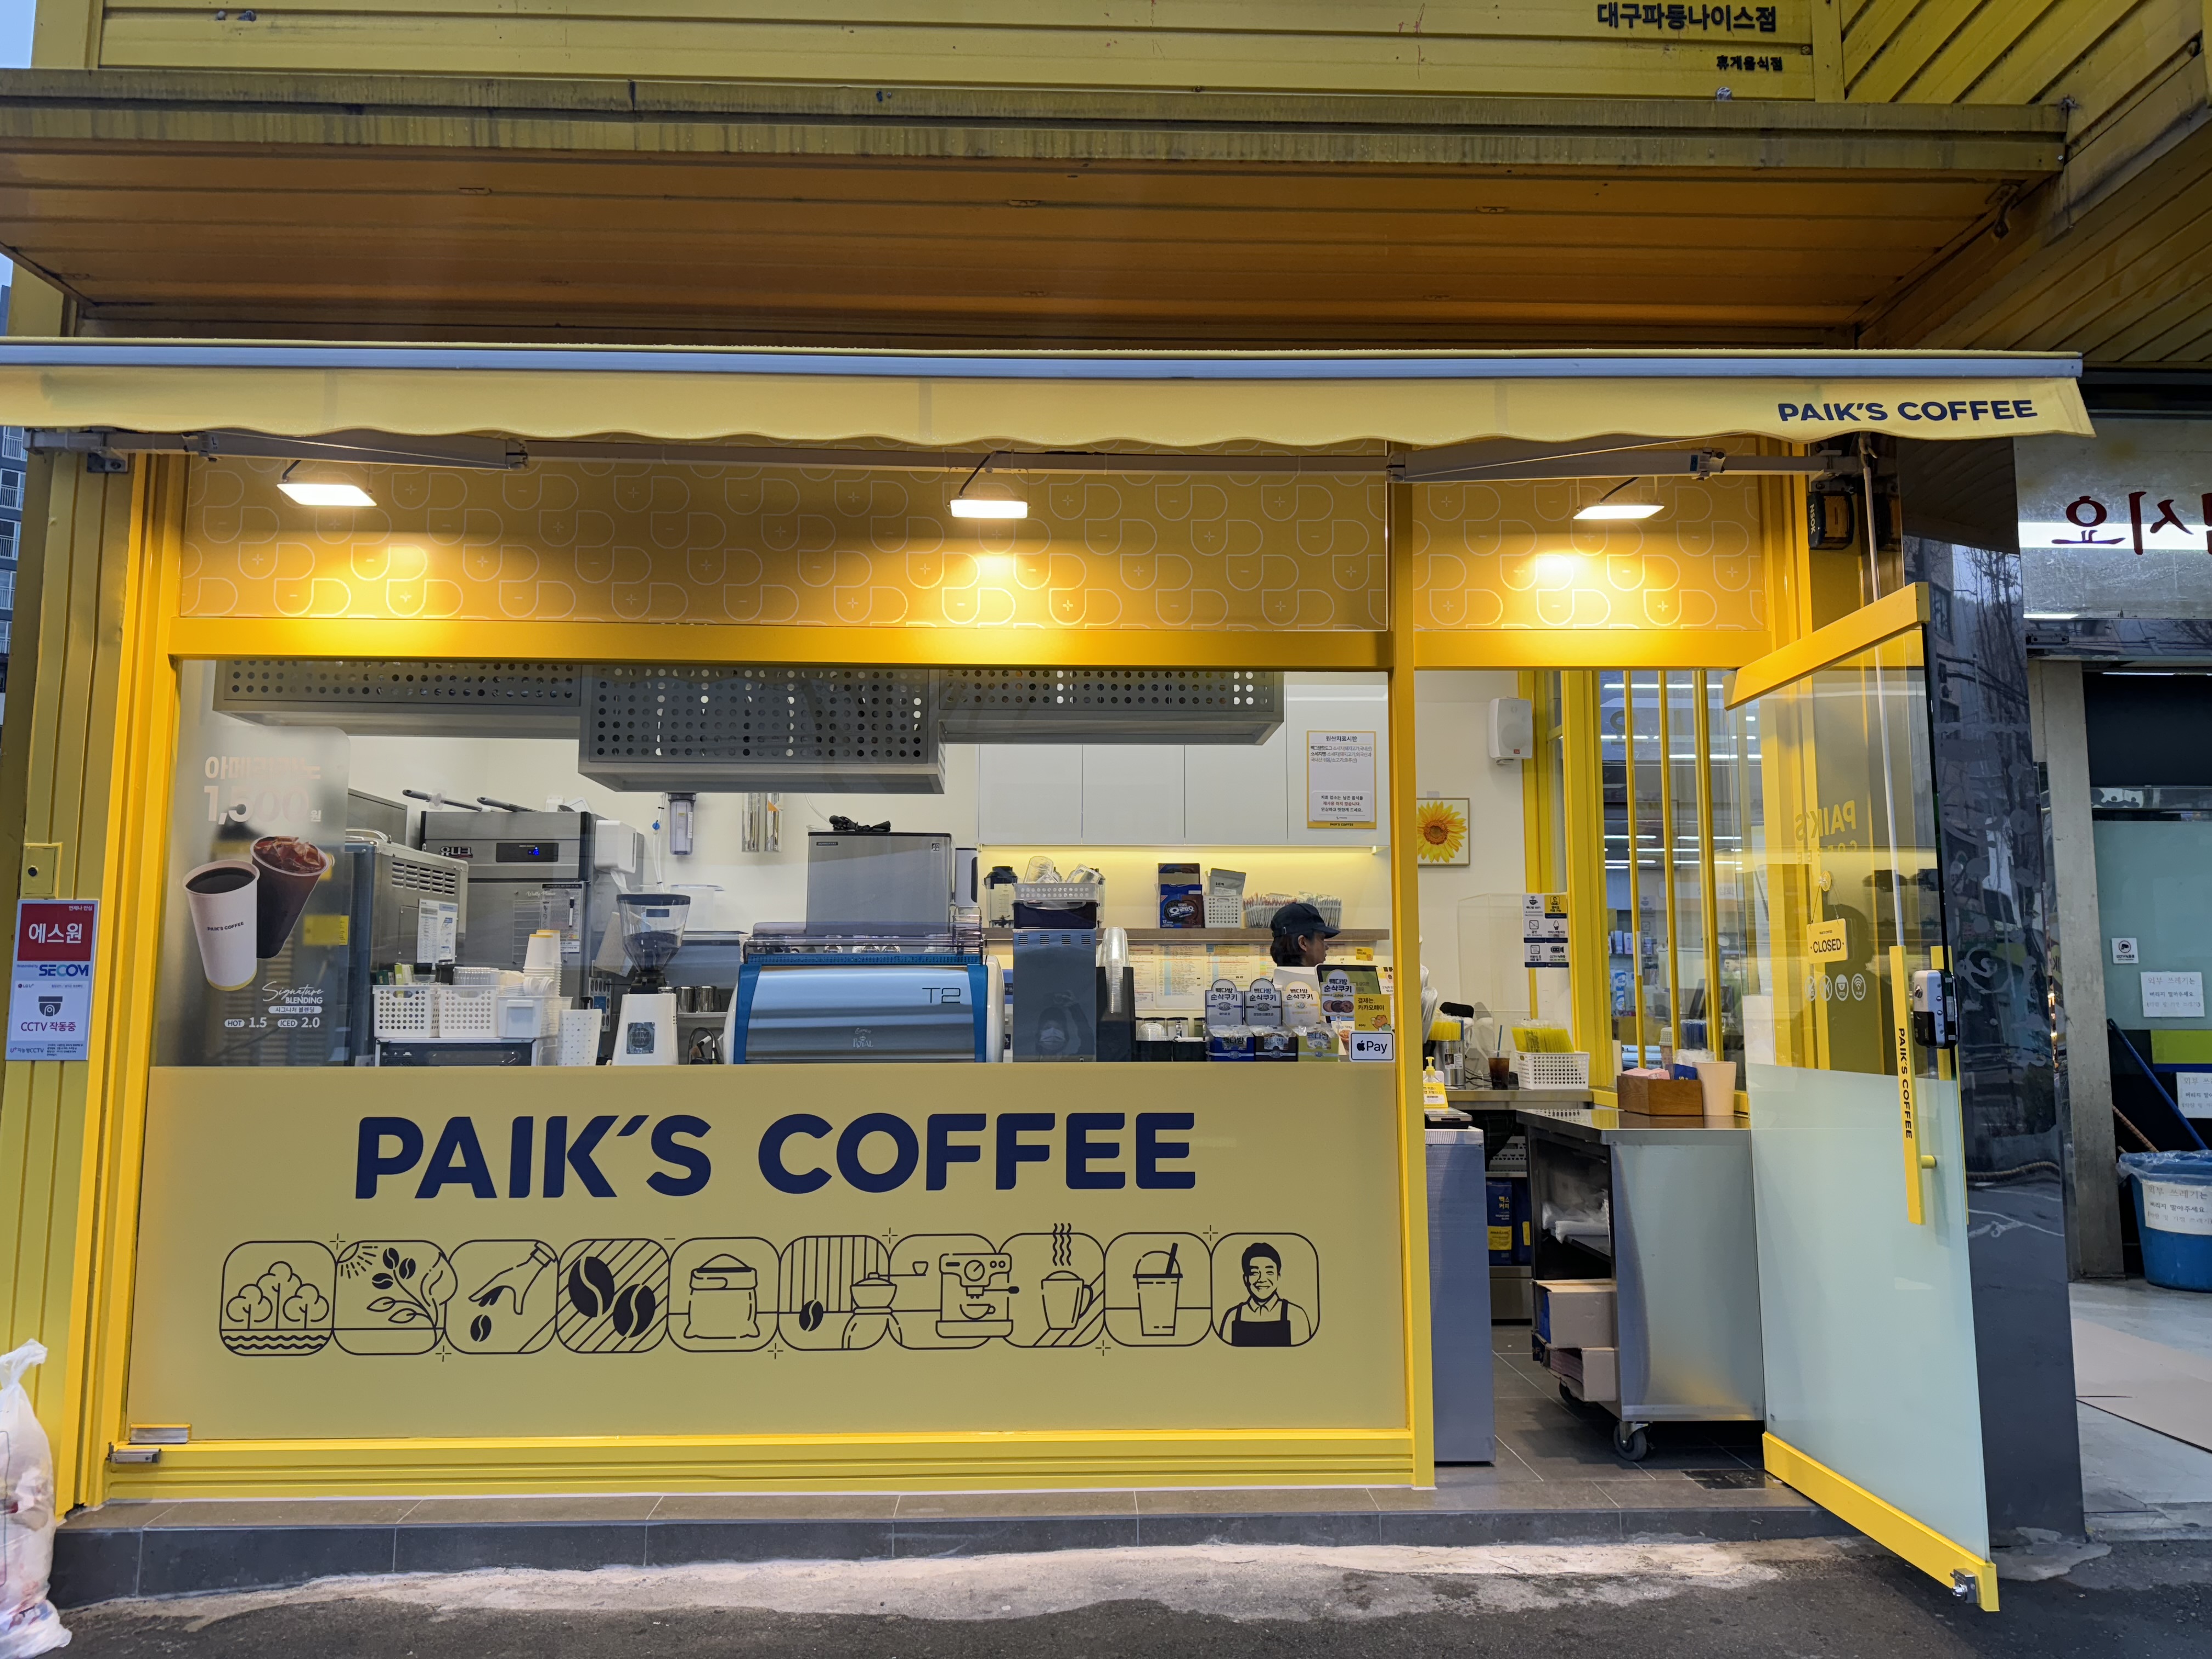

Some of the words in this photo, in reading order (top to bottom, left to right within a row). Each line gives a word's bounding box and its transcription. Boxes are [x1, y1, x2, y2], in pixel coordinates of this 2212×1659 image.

[1597, 2, 1776, 32] 대구파동나이스점
[1717, 55, 1783, 71] 휴게음식점
[1778, 402, 1888, 421] PAIK'S
[1898, 400, 2038, 421] COFFEE
[440, 846, 472, 857] 유니크
[29, 923, 82, 944] 에스원
[1813, 938, 1841, 953] CLOSED
[39, 964, 89, 977] SECOM
[262, 981, 324, 1001] Signature
[922, 988, 961, 1003] T2
[21, 1022, 47, 1031] CCTV
[49, 1022, 76, 1031] 작동중
[249, 1017, 267, 1028] 1.5
[301, 1017, 320, 1028] 2.0
[1367, 1041, 1387, 1054] Pay
[1899, 1028, 1908, 1074] PAIK'S
[1902, 1079, 1912, 1139] COFFEE
[356, 1114, 712, 1199] PAIK'S
[758, 1113, 1196, 1193] COFFEE
[2170, 1189, 2208, 1200] 쓰레기는
